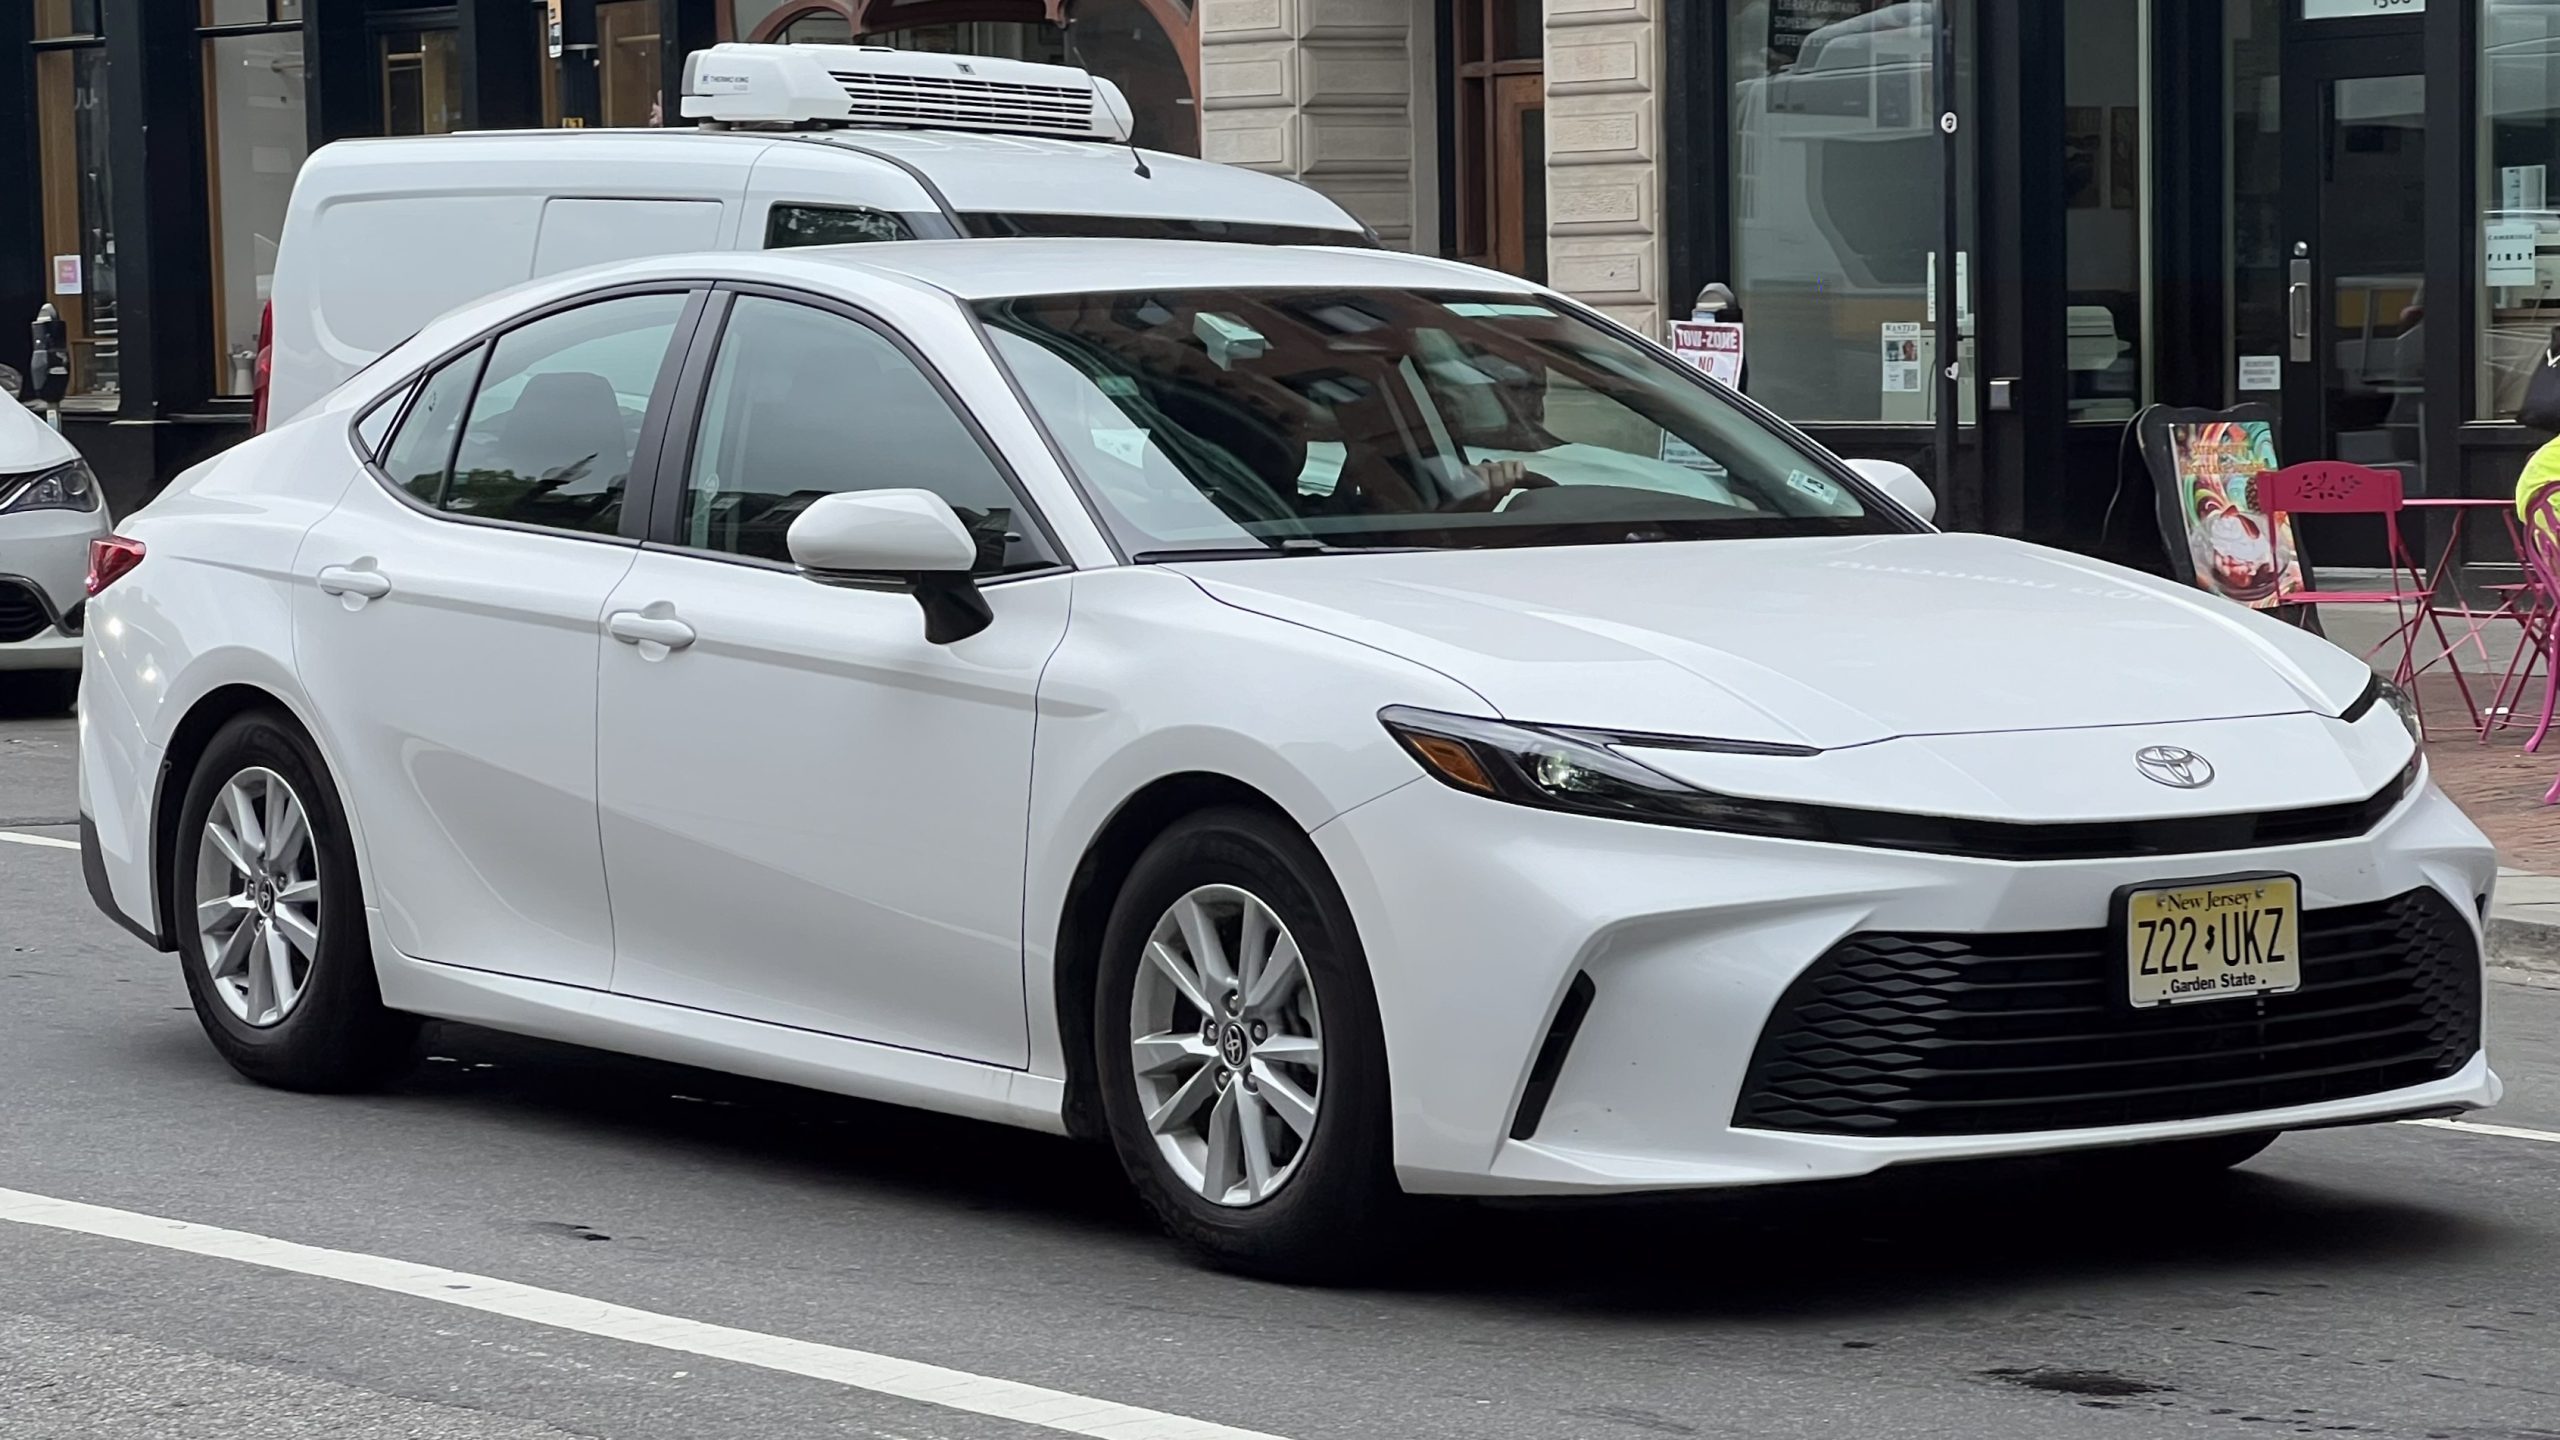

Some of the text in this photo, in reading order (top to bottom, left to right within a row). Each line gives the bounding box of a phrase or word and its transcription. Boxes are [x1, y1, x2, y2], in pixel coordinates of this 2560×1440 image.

[2487, 252, 2533, 261] FIRST
[1676, 328, 1738, 349] TOW-ZONE
[1698, 356, 1714, 373] NO
[2168, 890, 2253, 912] New Jersey
[2138, 907, 2285, 976] Z22 UKZ
[2170, 972, 2256, 994] Garden State
